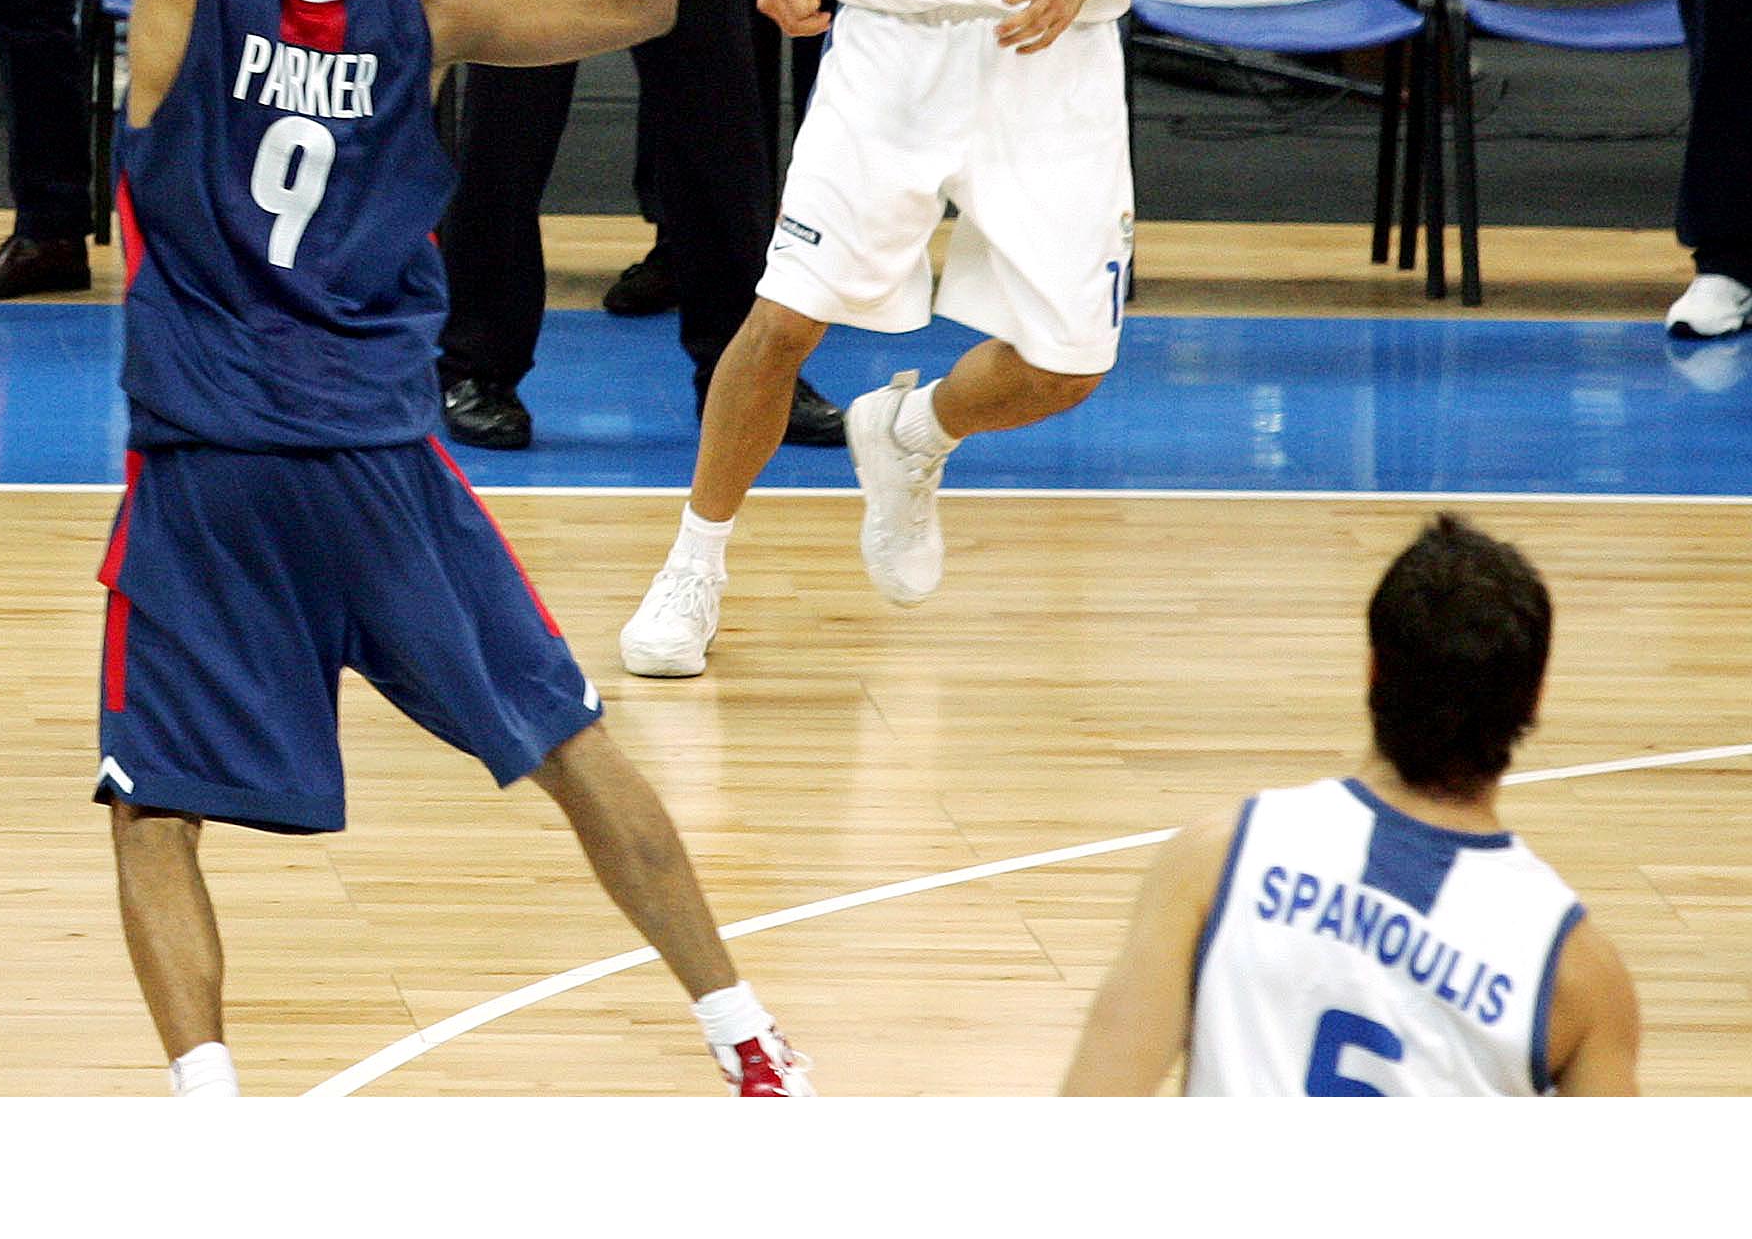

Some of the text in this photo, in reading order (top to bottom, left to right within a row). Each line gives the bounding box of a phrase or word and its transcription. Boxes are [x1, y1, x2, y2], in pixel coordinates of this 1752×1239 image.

[233, 33, 378, 119] PARKER
[250, 115, 337, 270] 9
[1256, 865, 1514, 1025] SPANOULIS
